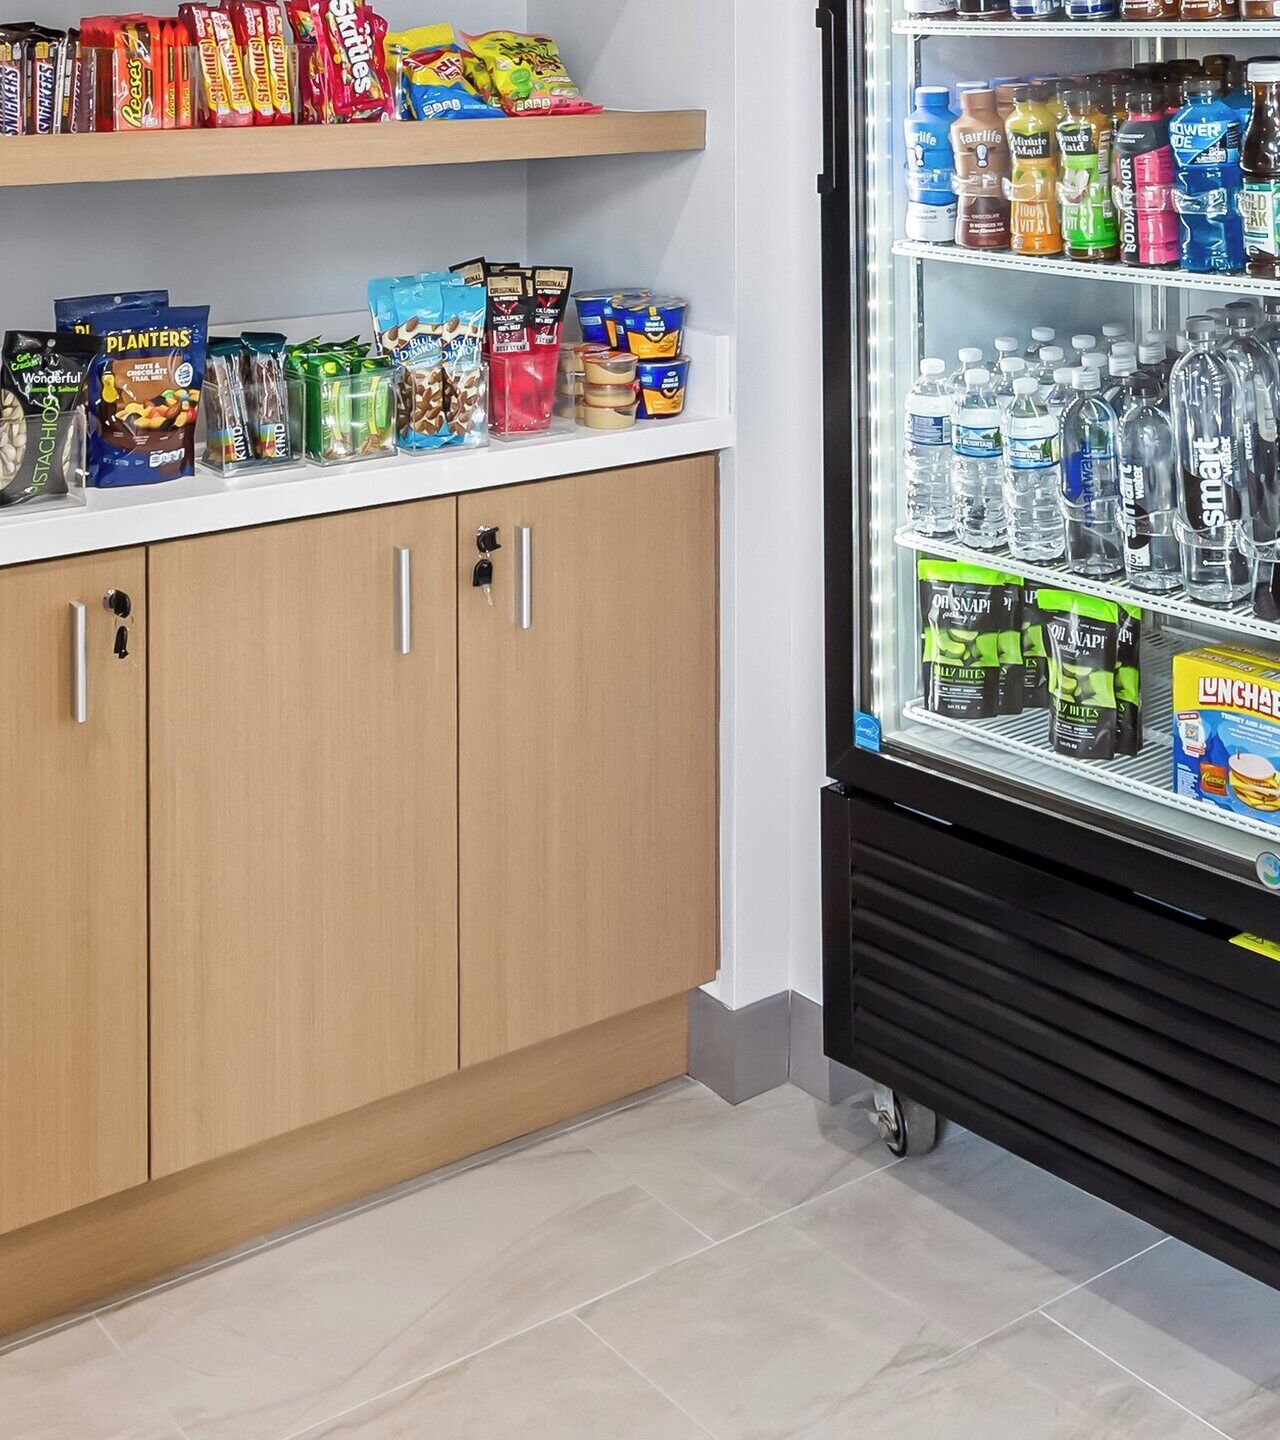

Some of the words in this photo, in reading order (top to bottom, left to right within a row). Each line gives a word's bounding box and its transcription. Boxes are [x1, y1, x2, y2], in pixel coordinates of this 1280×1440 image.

[2, 64, 20, 136] SNICKERS
[37, 62, 54, 134] SNICKERS
[960, 130, 1002, 145] fairlife
[1013, 137, 1047, 148] Minute
[1016, 146, 1043, 156] Maid
[1120, 158, 1137, 253] BODYARMOR
[489, 286, 520, 294] ORIGINAL
[536, 280, 565, 288] ORIGINAL
[107, 330, 191, 353] PLANTERS
[410, 335, 433, 350] BLUE
[23, 371, 81, 384] Wonderful
[127, 368, 168, 377] CHOCOLATE
[234, 426, 247, 460] KIND
[275, 423, 286, 457] KIND
[1221, 436, 1234, 478] water
[1194, 437, 1224, 528] smart
[933, 594, 949, 609] OH
[953, 596, 991, 613] SNAP!
[959, 668, 986, 679] BITES
[1069, 705, 1099, 719] BITES
[1221, 713, 1244, 727] TURKEY
[1246, 718, 1259, 729] AND
